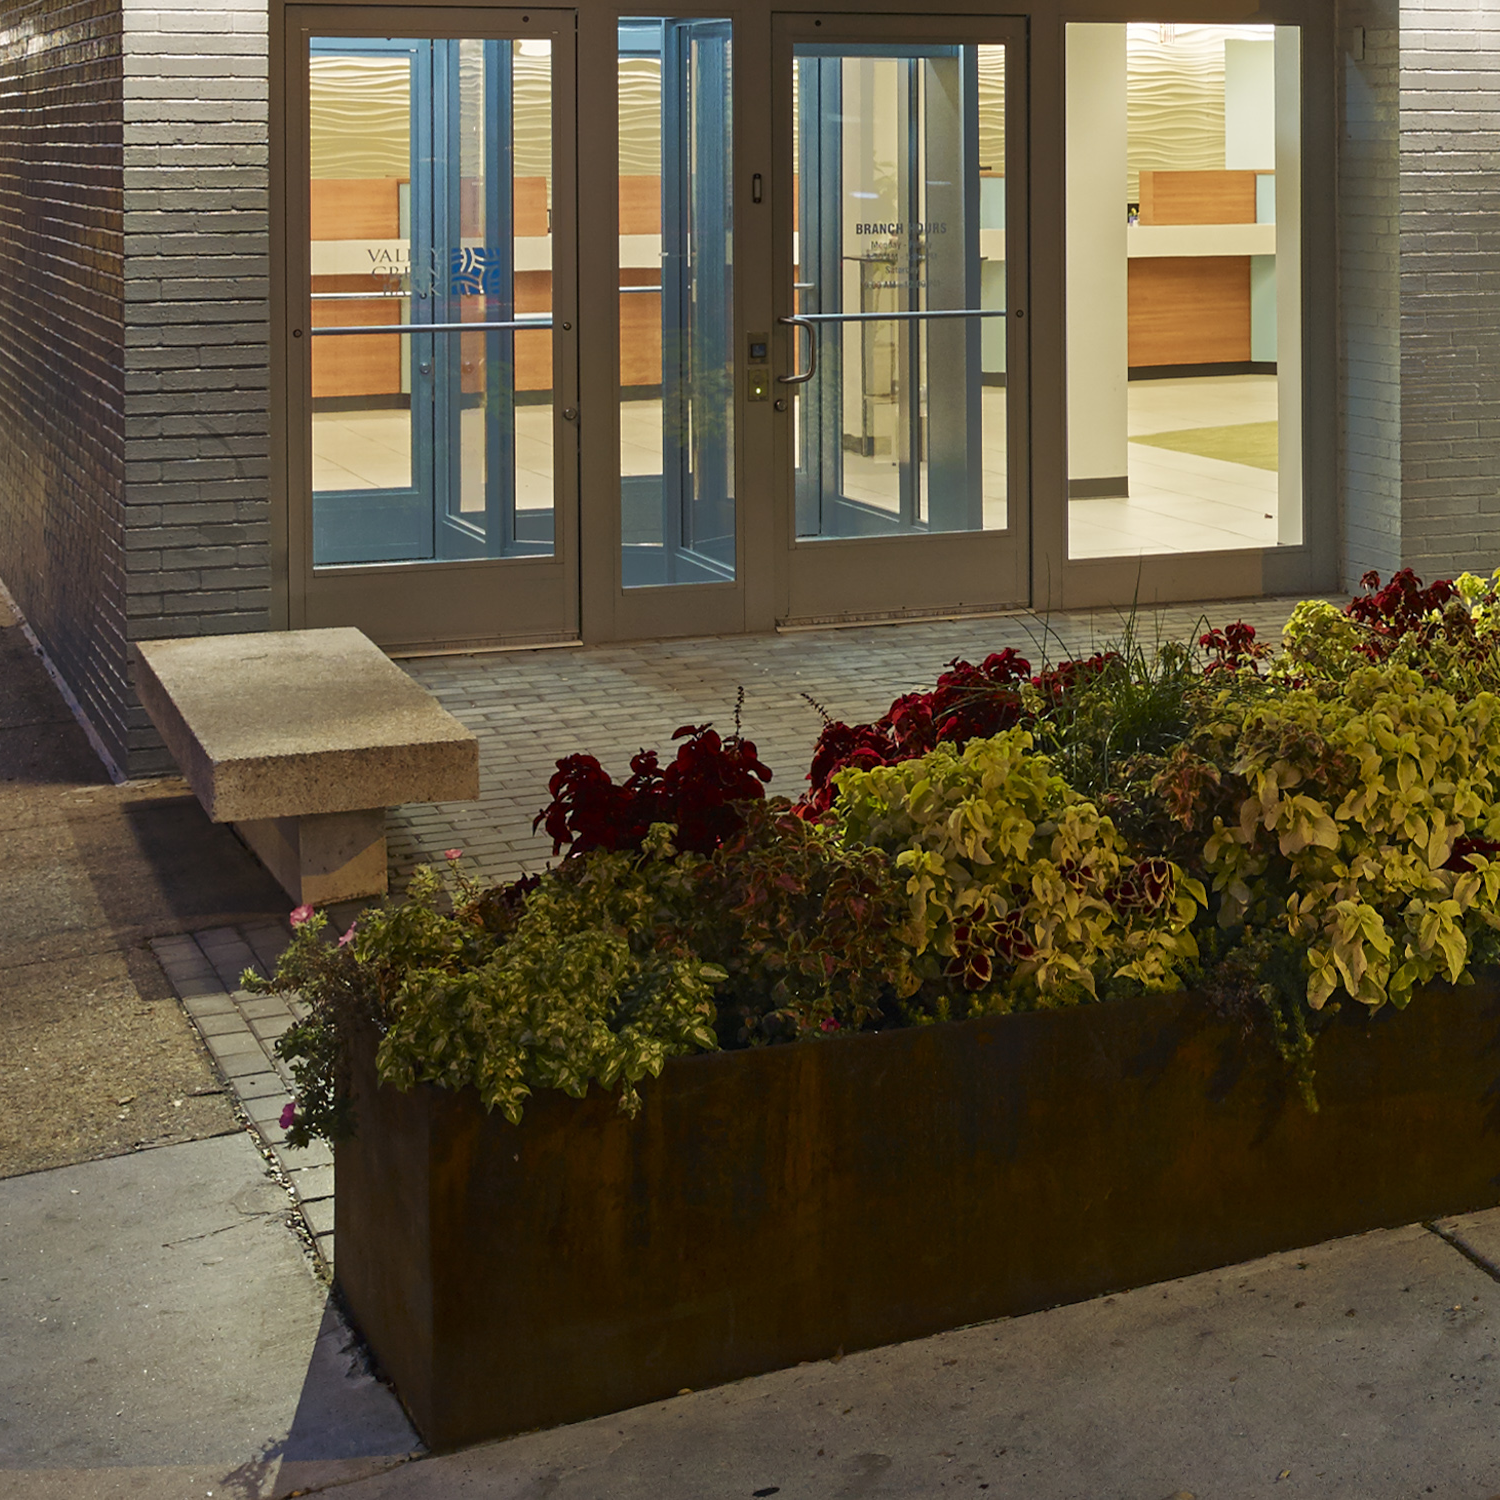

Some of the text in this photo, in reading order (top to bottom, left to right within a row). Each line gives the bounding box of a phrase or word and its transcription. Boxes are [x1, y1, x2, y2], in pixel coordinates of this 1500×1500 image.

[856, 223, 903, 234] BRANCH
[366, 248, 443, 263] VALY
[371, 265, 441, 280] GREN
[885, 266, 919, 274] Satury
